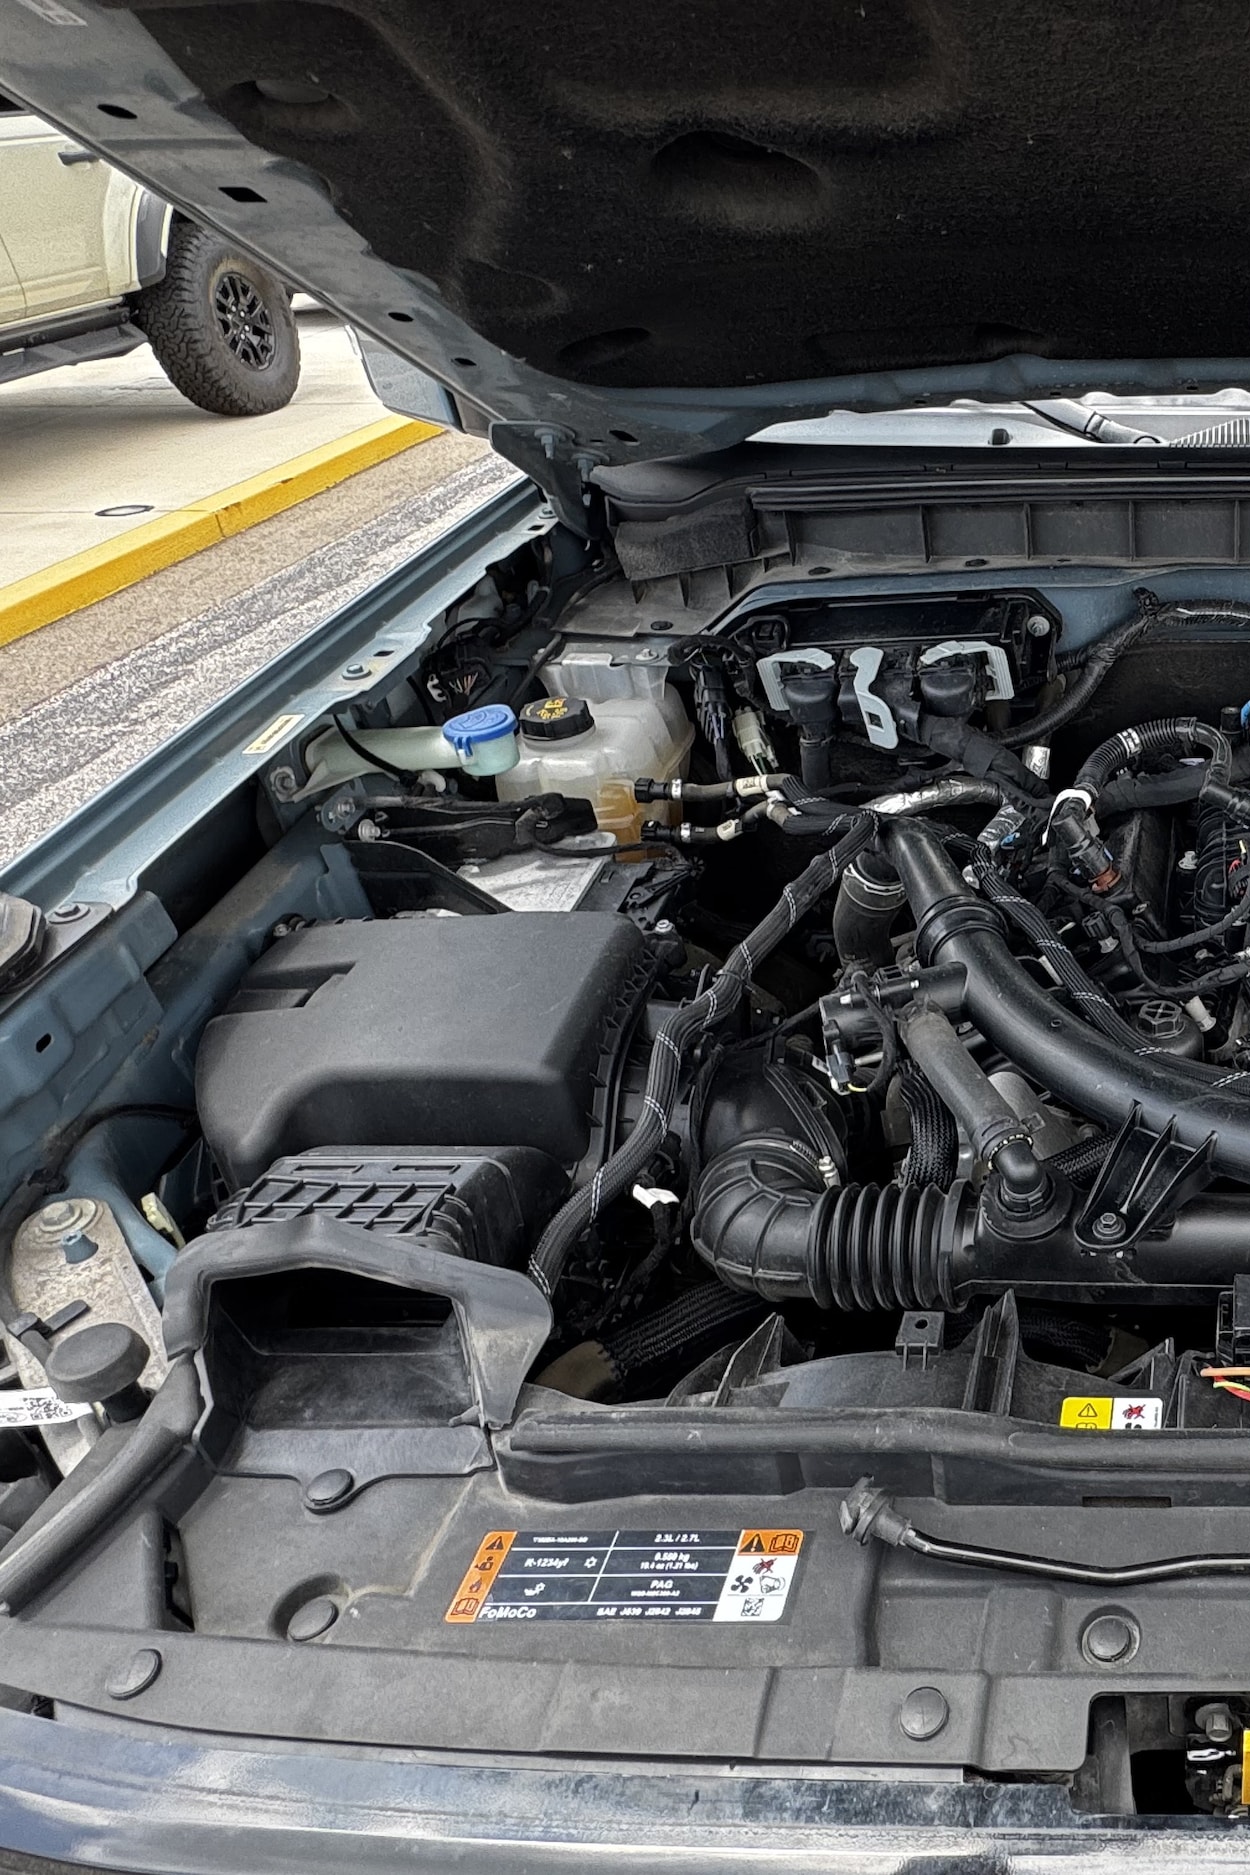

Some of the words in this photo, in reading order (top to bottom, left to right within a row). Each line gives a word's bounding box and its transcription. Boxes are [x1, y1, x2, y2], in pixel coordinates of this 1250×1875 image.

[654, 1534, 674, 1543] 2.3L
[681, 1534, 700, 1543] 2.7L
[524, 1557, 570, 1569] R-1234yf
[650, 1580, 674, 1589] PAG
[479, 1606, 537, 1619] FoMoCo
